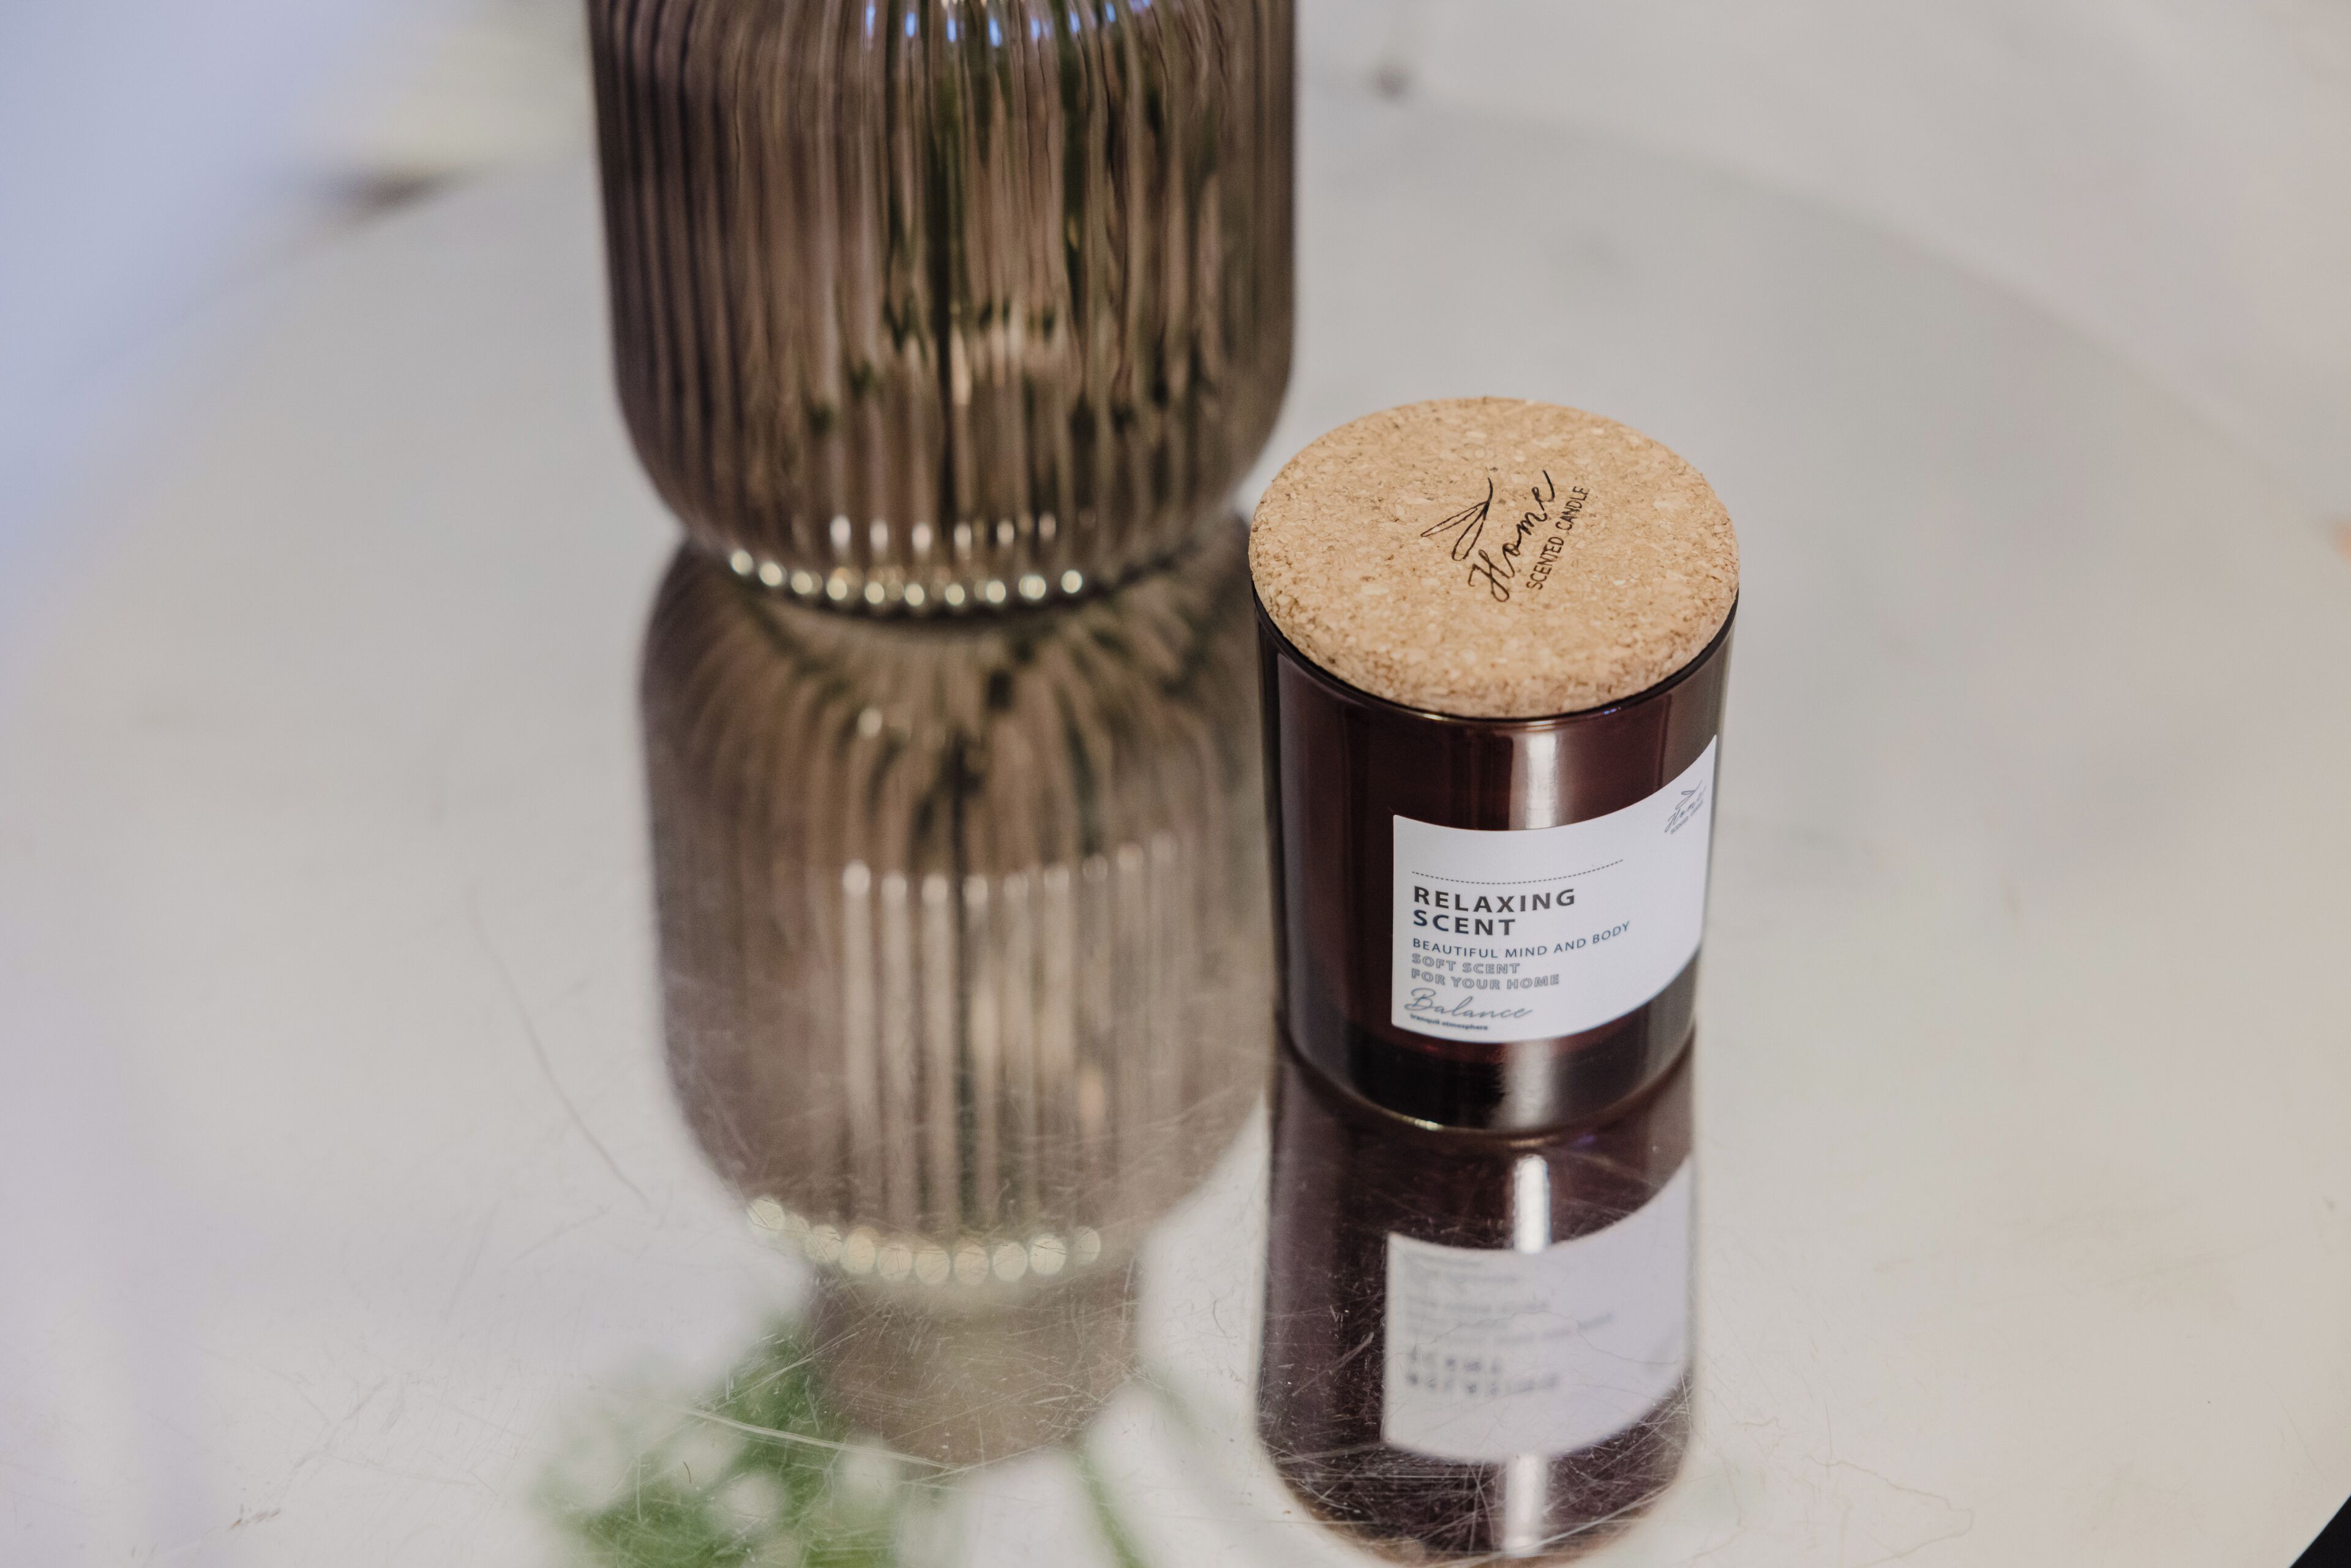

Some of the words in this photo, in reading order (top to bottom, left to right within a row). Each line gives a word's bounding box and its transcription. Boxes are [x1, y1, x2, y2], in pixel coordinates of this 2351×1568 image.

[1468, 470, 1555, 602] Home
[1526, 536, 1564, 590] SCENTED
[1555, 486, 1589, 531] CANDLE
[1412, 885, 1576, 913] RELAXING
[1412, 909, 1517, 936] SCENT
[1412, 937, 1498, 958] BEAUTIFUL
[1505, 945, 1548, 958] MIND
[1553, 937, 1587, 953] AND
[1592, 920, 1630, 944] BODY
[1412, 953, 1457, 971] SOFT
[1462, 962, 1520, 974] SCENT
[1411, 968, 1445, 985] FOR
[1450, 976, 1501, 990] YOUR
[1506, 973, 1560, 989] HOME
[1404, 987, 1533, 1019] Balance
[1409, 1013, 1441, 1026] tranquil
